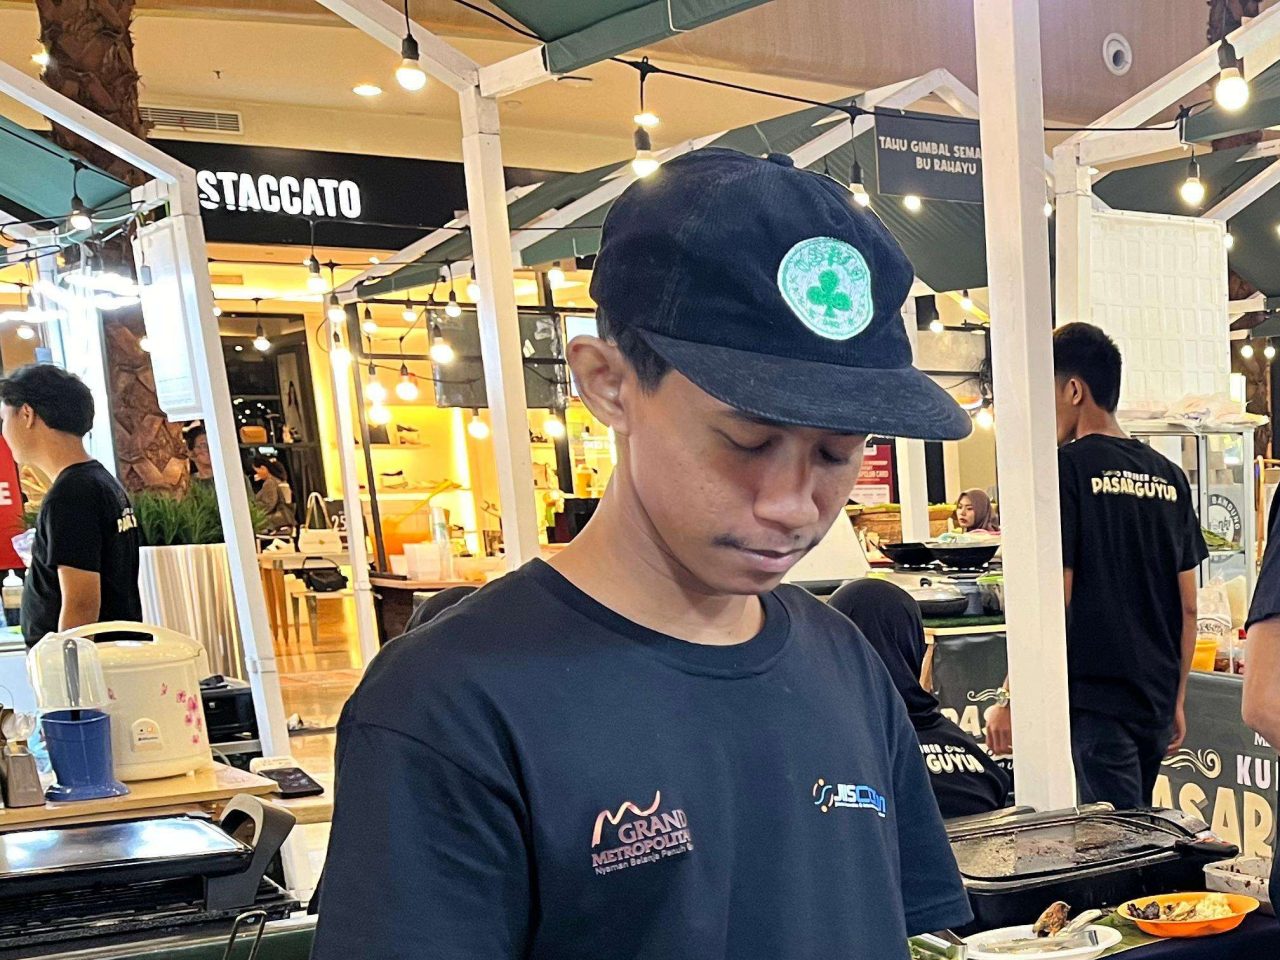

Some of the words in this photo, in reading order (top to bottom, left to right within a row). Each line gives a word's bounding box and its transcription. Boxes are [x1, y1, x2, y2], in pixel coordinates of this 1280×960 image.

[879, 136, 907, 151] TAHU
[910, 140, 950, 156] GIMBAL
[915, 157, 931, 170] BU
[933, 159, 976, 175] RAHAYU
[196, 170, 362, 219] STACCATO
[618, 809, 688, 843] GRAND
[595, 861, 629, 875] Nyaman
